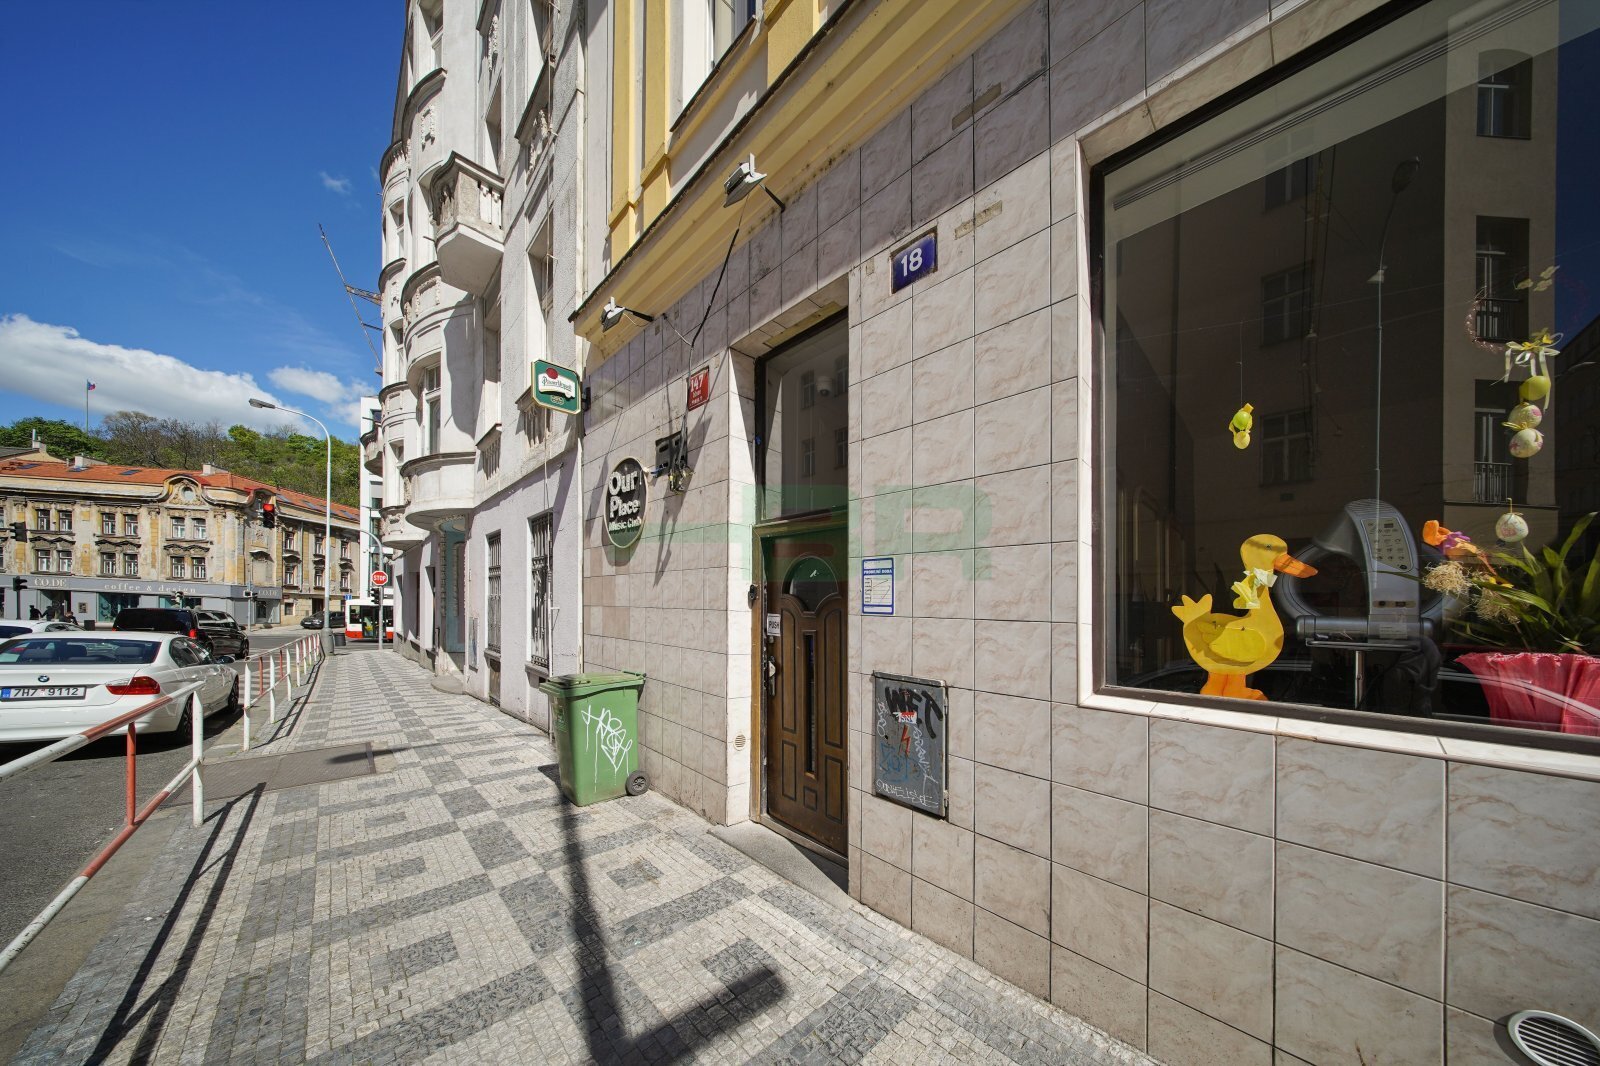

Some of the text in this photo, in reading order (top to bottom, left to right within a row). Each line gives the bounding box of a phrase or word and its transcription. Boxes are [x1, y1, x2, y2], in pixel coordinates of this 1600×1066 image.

[901, 247, 923, 277] 18
[608, 471, 638, 496] Our
[609, 496, 640, 518] Place
[608, 521, 627, 531] Music
[34, 578, 67, 587] CO.DE
[104, 582, 141, 591] coffee
[158, 584, 196, 594] design
[14, 688, 38, 697] 7H7
[48, 687, 79, 696] 9112
